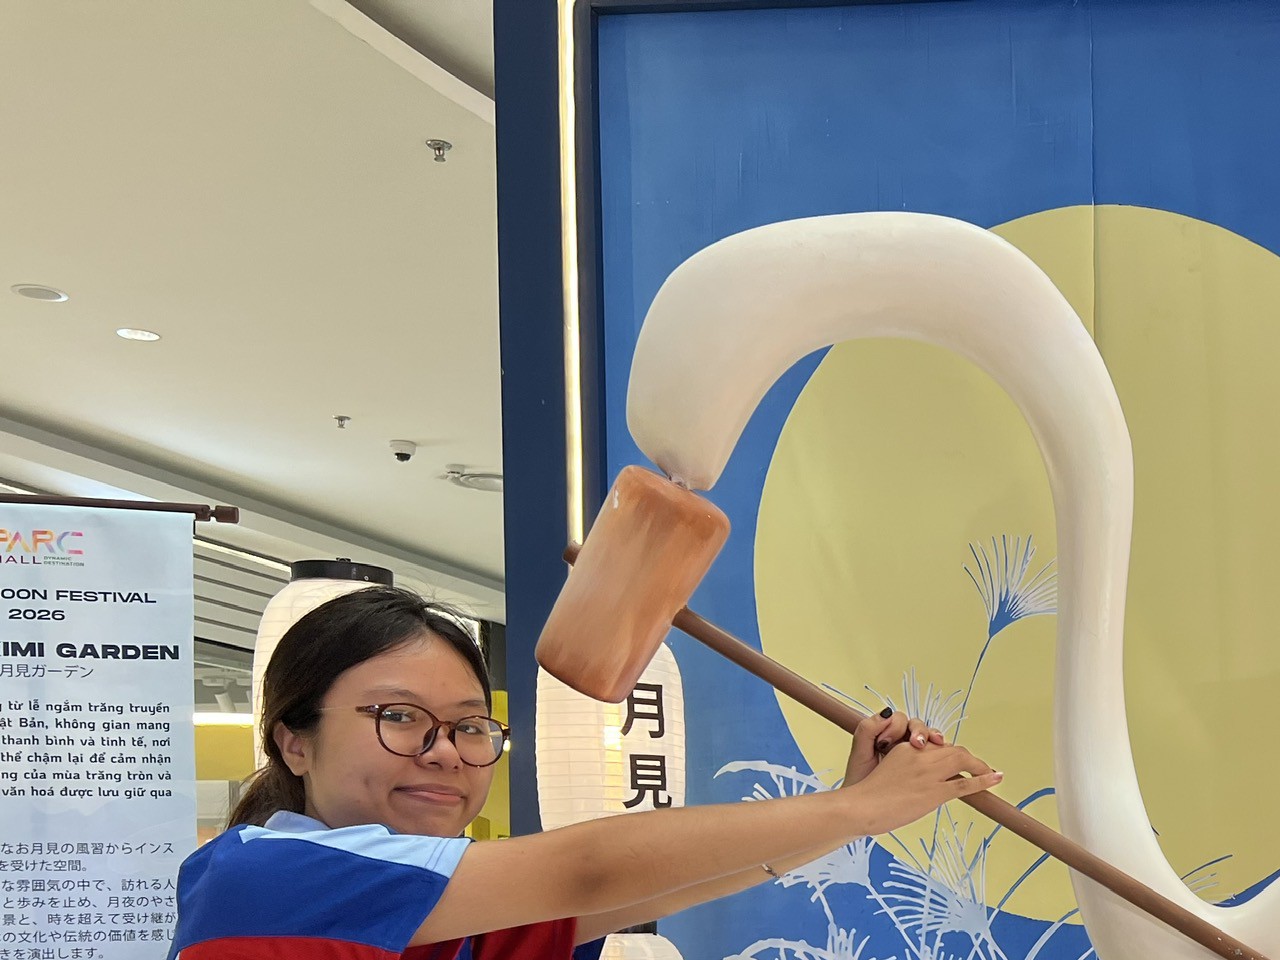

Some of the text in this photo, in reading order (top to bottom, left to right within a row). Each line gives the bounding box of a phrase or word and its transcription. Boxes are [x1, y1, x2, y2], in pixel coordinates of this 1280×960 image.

[1, 589, 157, 604] OON FESTIVAL
[8, 608, 66, 621] 2026
[0, 641, 180, 661] IMI GARDEN
[0, 663, 94, 679] 月見ガーデン
[8, 700, 23, 712] từ
[29, 698, 40, 712] lễ
[46, 699, 82, 714] ngắm
[88, 701, 124, 715] trăng
[19, 716, 171, 733] Bản, không gian mang
[1, 734, 40, 746] thanh
[45, 735, 75, 747] bình
[80, 736, 96, 747] và
[100, 736, 127, 748] tinh
[152, 736, 171, 748] nơi
[621, 683, 671, 809] 月見
[1, 750, 172, 766] thể chậm lại để cảm nhận
[23, 768, 47, 780] của
[52, 770, 81, 781] mùa
[86, 770, 123, 783] trăng
[127, 770, 154, 781] tròn
[2, 786, 173, 800] văn hoá được lưu giữ qua
